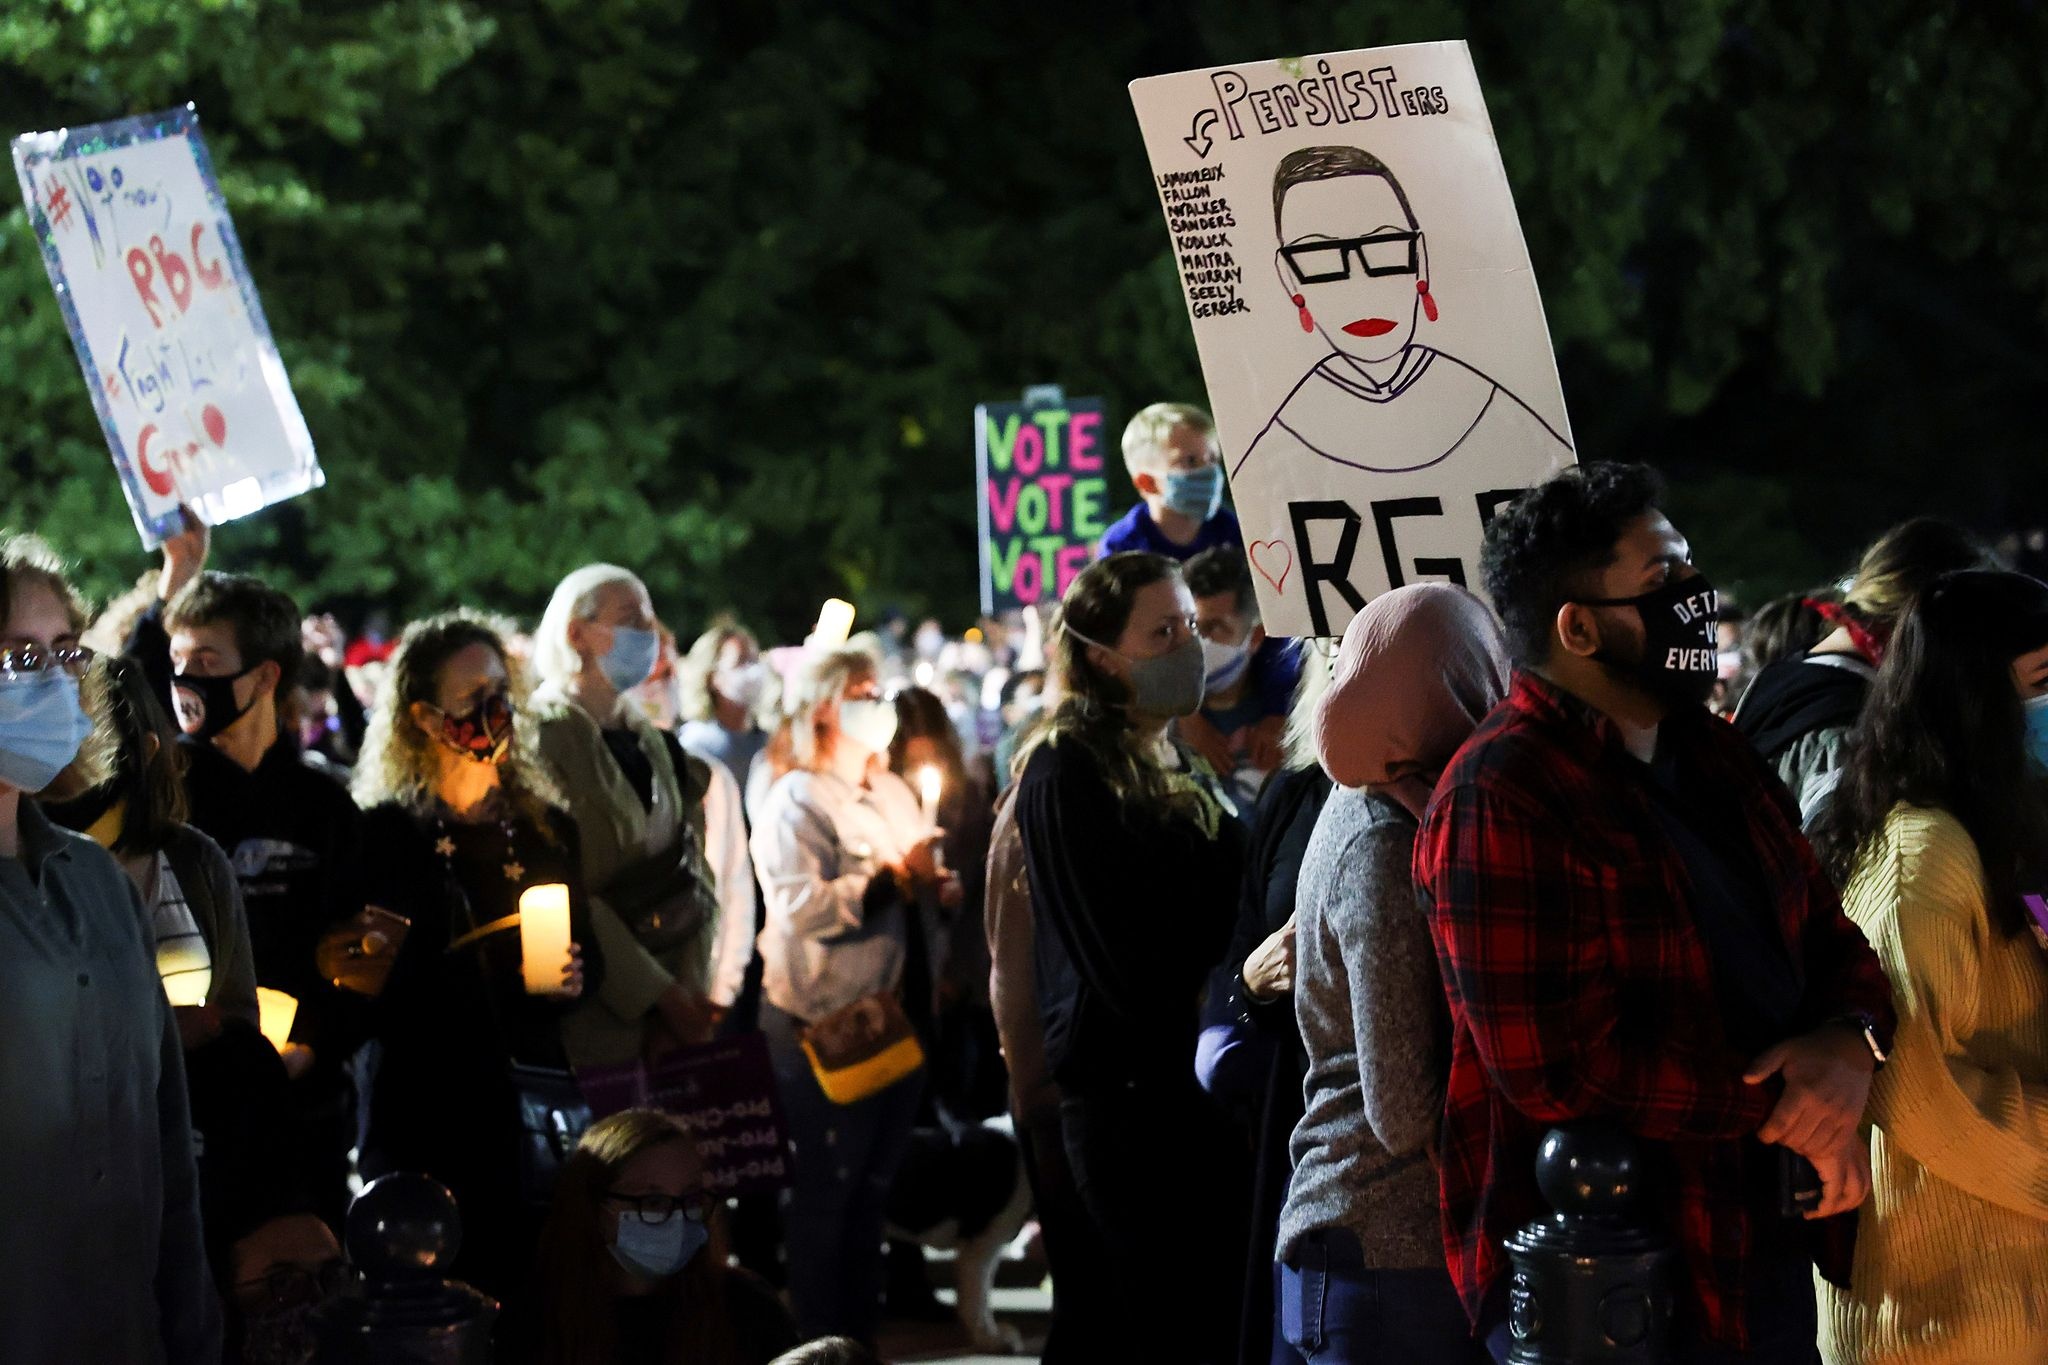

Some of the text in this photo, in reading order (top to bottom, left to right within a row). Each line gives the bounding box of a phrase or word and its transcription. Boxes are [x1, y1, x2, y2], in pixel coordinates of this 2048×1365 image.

[1162, 184, 1211, 203] FALLON
[1170, 213, 1236, 233] SANDERS
[1181, 251, 1235, 270] MAITRA
[1184, 266, 1242, 286] MURRAY
[1189, 284, 1235, 301] SEELY
[1192, 298, 1251, 319] GERBER
[986, 409, 1104, 476] VOTE
[988, 473, 1108, 539] VOTE
[1288, 488, 1535, 636] RG
[1665, 647, 1718, 671] EVERY
